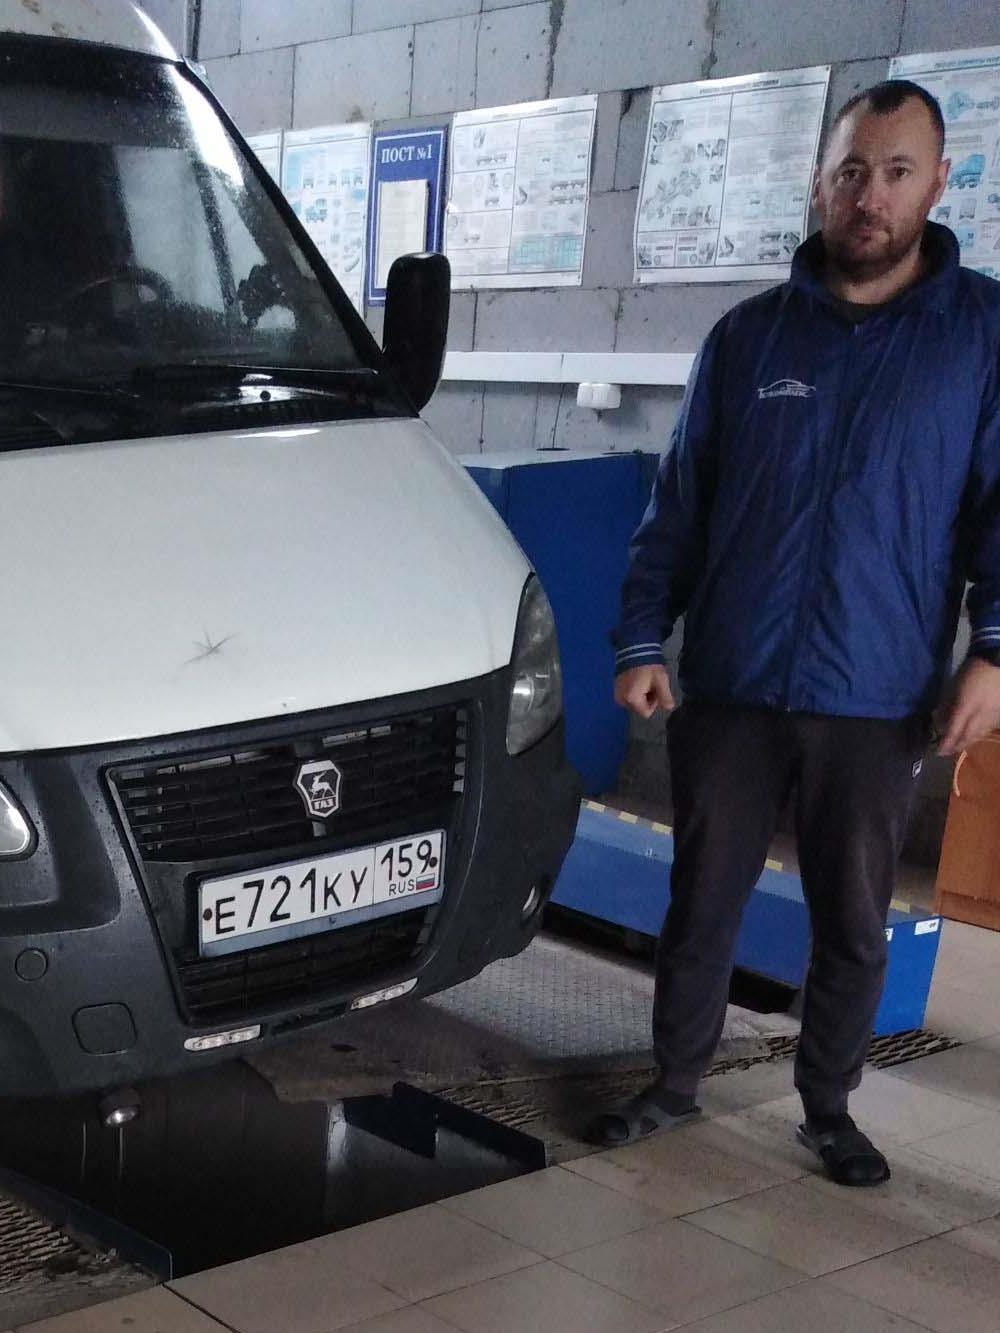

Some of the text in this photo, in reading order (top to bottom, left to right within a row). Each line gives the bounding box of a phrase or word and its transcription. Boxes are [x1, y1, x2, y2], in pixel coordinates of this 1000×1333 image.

[381, 144, 432, 163] ПОСТ №1
[314, 799, 334, 809] ГАЗ
[381, 839, 432, 880] 159
[388, 878, 416, 896] RUS
